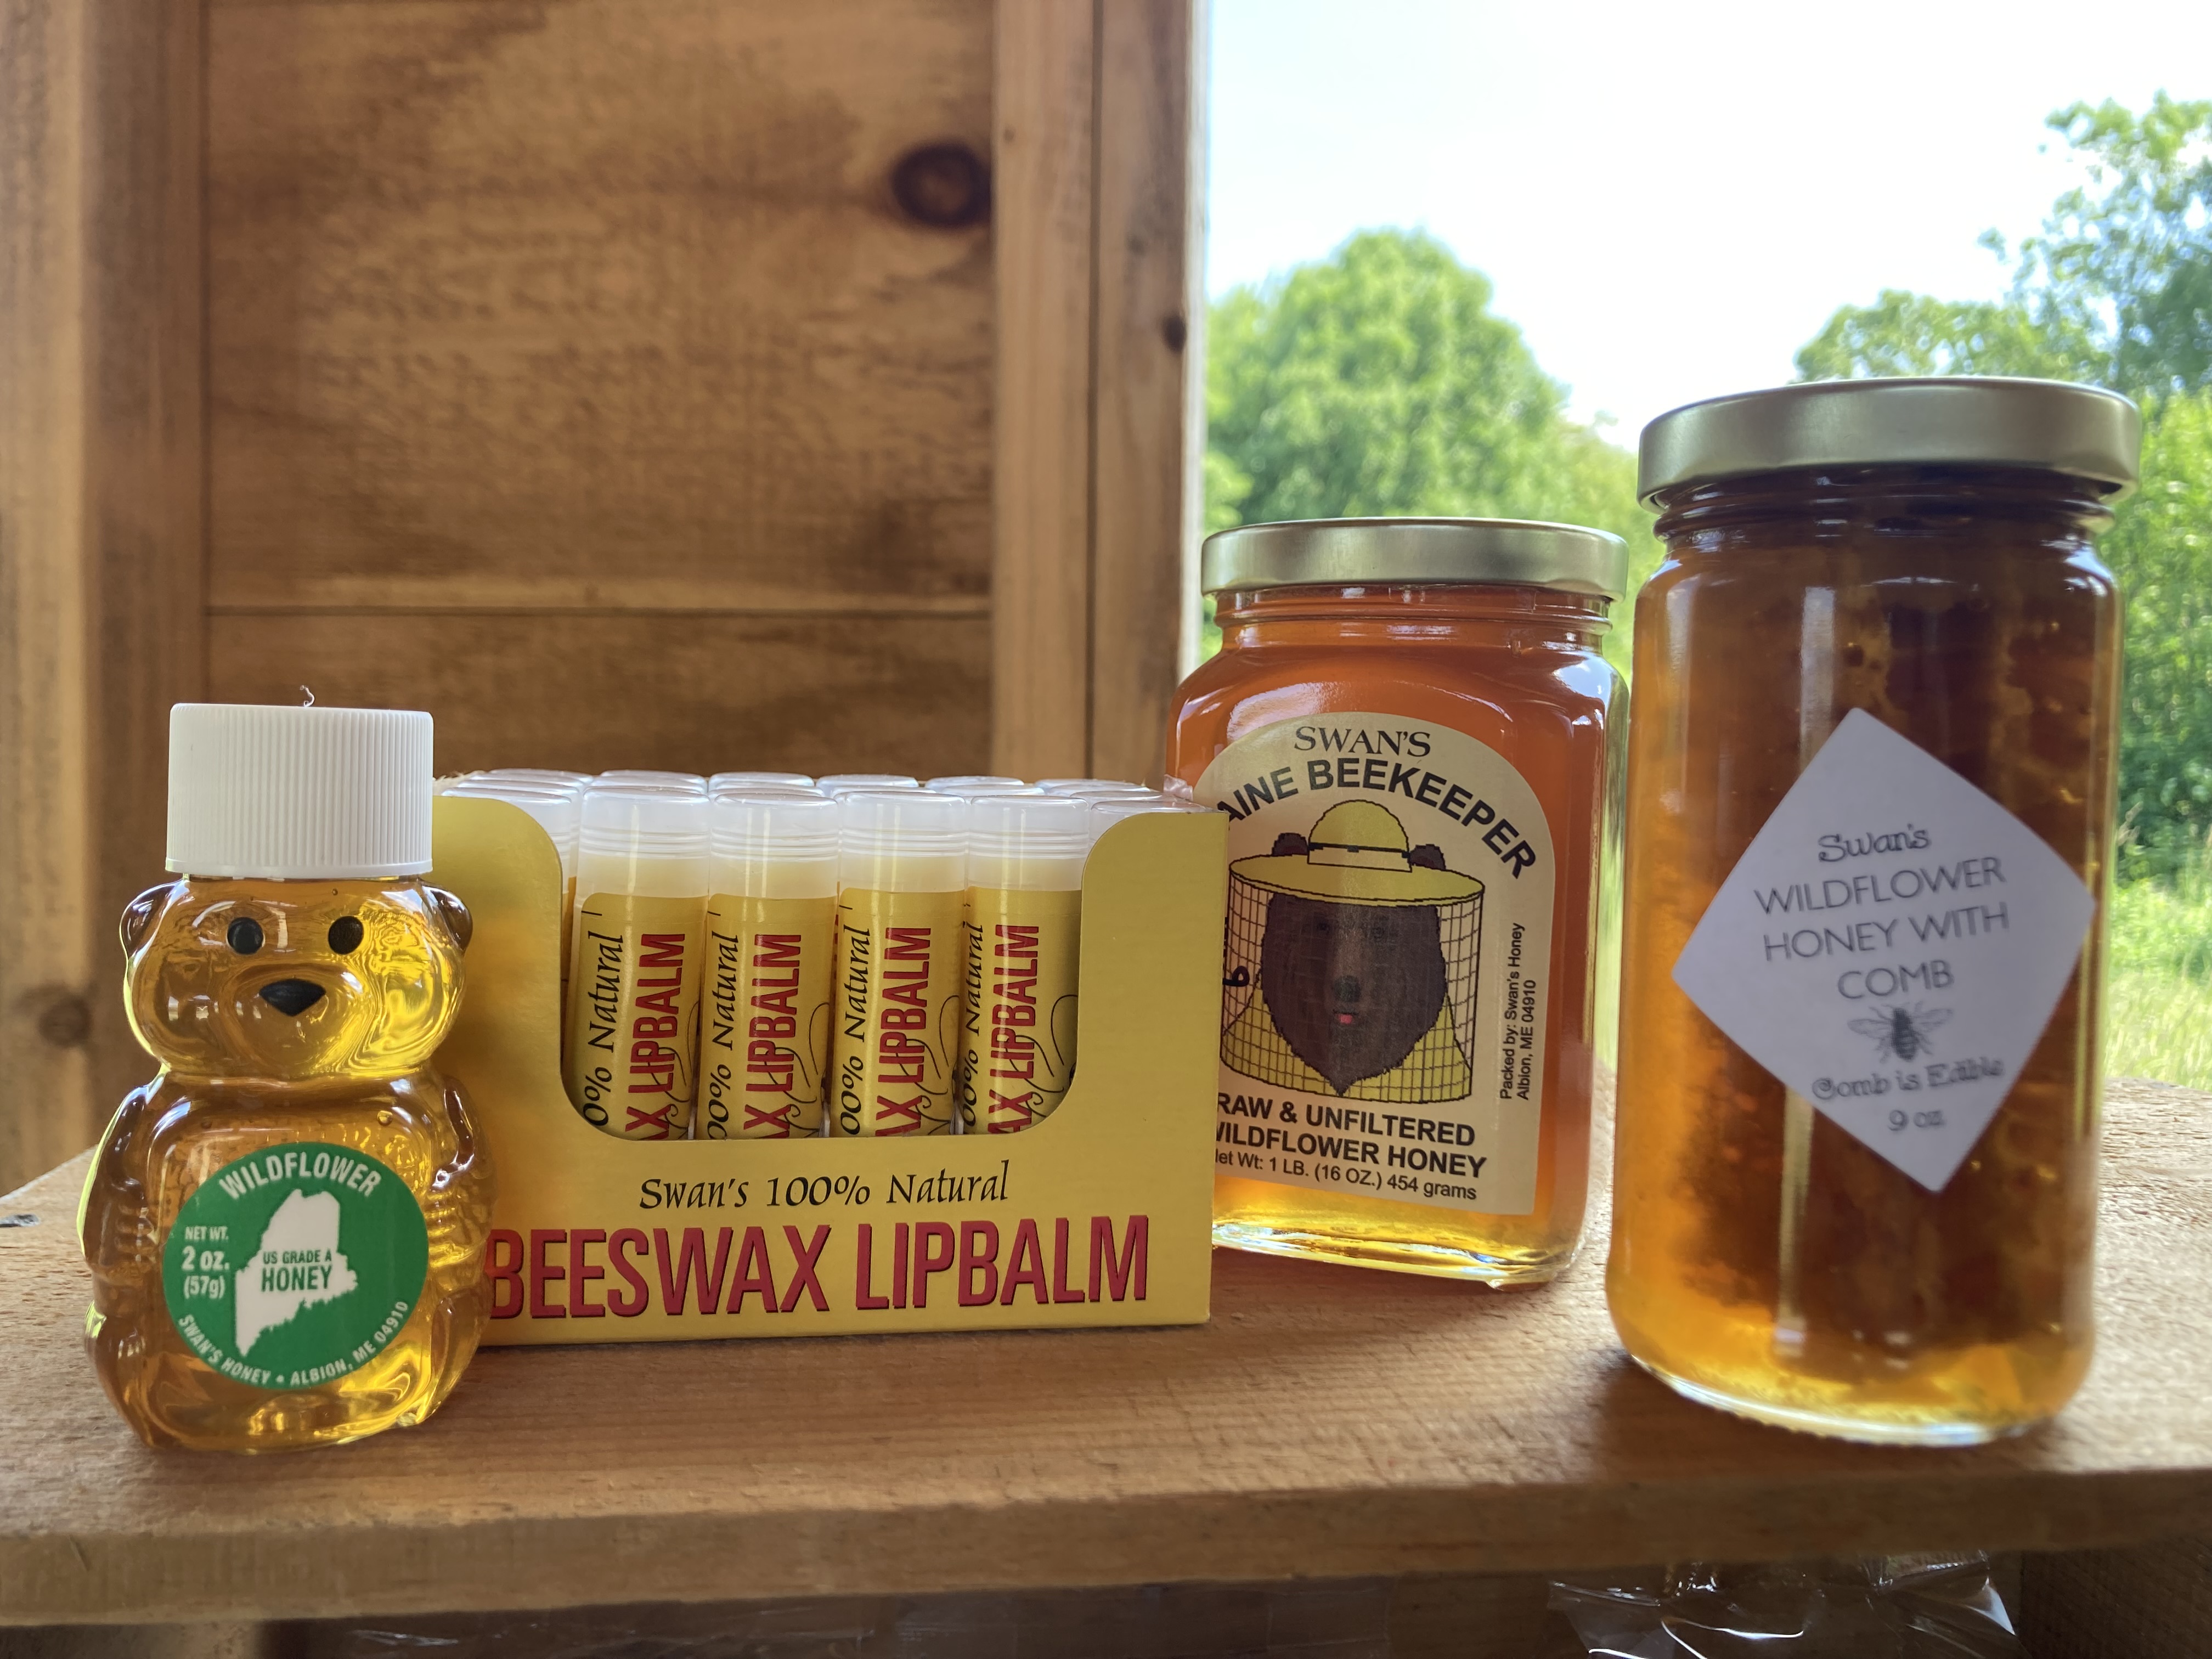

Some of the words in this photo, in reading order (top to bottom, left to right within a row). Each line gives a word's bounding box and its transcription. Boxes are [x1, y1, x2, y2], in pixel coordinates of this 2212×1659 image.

[1295, 726, 1431, 757] SWAN'S
[1217, 766, 1299, 822] AINE
[1307, 757, 1536, 879] BEEKEEPER
[1818, 823, 1931, 862] Swan's
[1754, 856, 2007, 915] WILDFLOWER
[1508, 922, 1525, 967] Honey
[1763, 918, 1899, 962] HONEY
[1909, 901, 2010, 943] WITH
[588, 930, 624, 1053] Natural
[712, 930, 738, 1051] Natural
[843, 924, 871, 1043] Natural
[963, 921, 984, 1037] Natural
[990, 924, 1040, 1079] LIPBALM
[1504, 970, 1520, 1020] Swan's
[1521, 979, 1537, 1023] 04910
[1837, 960, 1954, 999] COMB
[628, 933, 685, 1093] LIPBALM
[746, 934, 802, 1092] LIPBALM
[878, 927, 932, 1084] LIPBALM
[1503, 1024, 1519, 1044] by:
[1520, 1026, 1533, 1049] ME
[840, 1055, 864, 1135] 00%
[962, 1048, 979, 1127] 00%
[1499, 1048, 1515, 1099] Packed
[1516, 1053, 1534, 1101] Albion,
[1812, 1072, 1889, 1100] Comb
[1895, 1069, 1921, 1091] is
[1924, 1056, 2004, 1087] Edible
[707, 1064, 732, 1139] 00%
[1217, 1092, 1273, 1120] RAW
[1279, 1101, 1297, 1124] &
[1306, 1104, 1475, 1147] UNFILTERED
[1888, 1109, 1908, 1131] 9
[1914, 1110, 1944, 1127] oz
[219, 1151, 382, 1200] WILDFLOWER
[639, 1178, 749, 1210] Swan's
[767, 1173, 870, 1207] 100%
[887, 1159, 1010, 1205] Natural
[1215, 1148, 1233, 1166] et
[1238, 1151, 1263, 1170] Wt:
[1269, 1156, 1276, 1171] 1
[1283, 1158, 1310, 1176] LB.
[1314, 1163, 1341, 1182] (16
[1346, 1168, 1383, 1191] OZ.)
[1387, 1173, 1419, 1193] 454
[1424, 1180, 1477, 1201] grams
[1387, 1144, 1487, 1180] HONEY
[181, 1245, 196, 1272] 2
[185, 1225, 207, 1241] NET
[209, 1225, 229, 1241] WT.
[263, 1251, 278, 1265] US
[282, 1250, 321, 1264] GRADE
[324, 1248, 332, 1262] A
[183, 1274, 225, 1300] (57g)
[261, 1264, 332, 1293] HONEY
[484, 1223, 832, 1319] BEESWAX
[855, 1214, 1150, 1310] LIPBALM
[178, 1314, 223, 1364] SWAN'S
[221, 1357, 272, 1385] HONEY
[290, 1358, 354, 1387] ALBION,
[352, 1340, 376, 1368] ME
[374, 1301, 409, 1344] 04910
